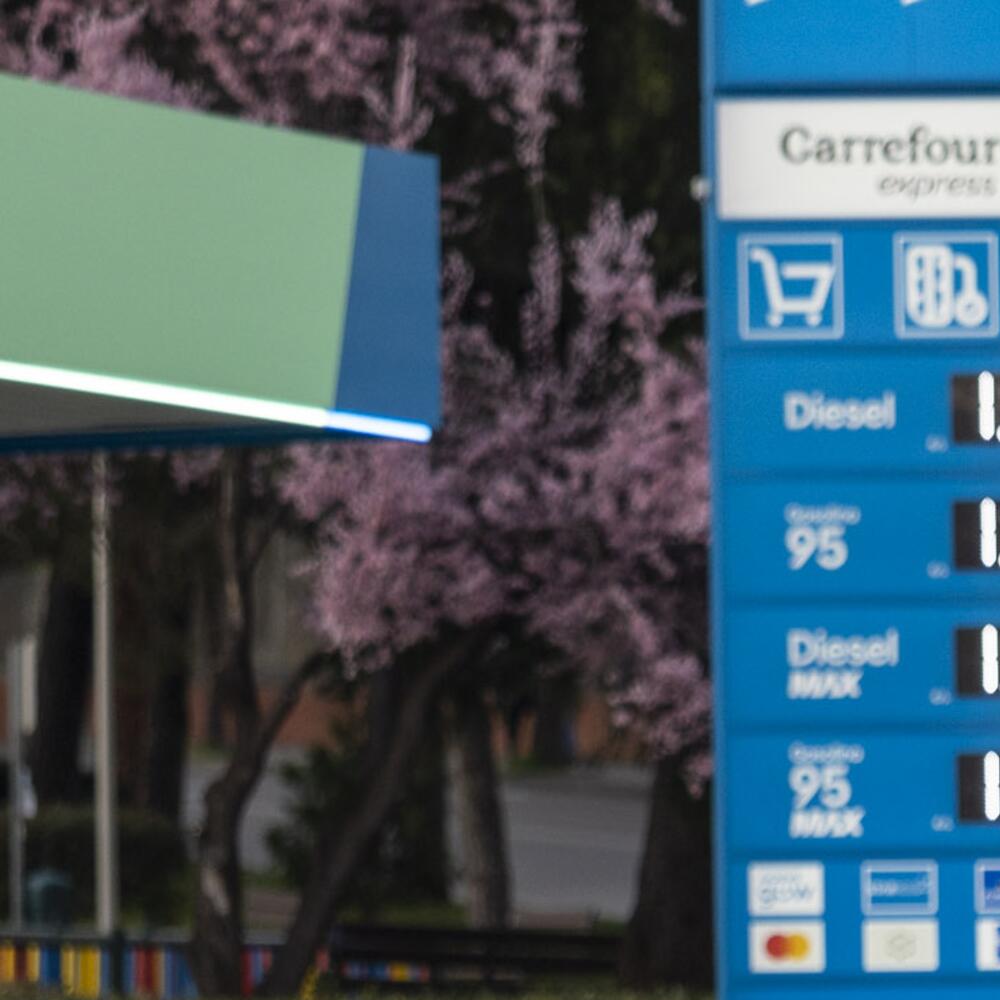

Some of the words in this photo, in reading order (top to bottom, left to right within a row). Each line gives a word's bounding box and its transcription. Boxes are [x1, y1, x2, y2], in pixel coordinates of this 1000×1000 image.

[779, 123, 1000, 165] Carrefour
[876, 172, 997, 202] express
[784, 392, 895, 430] Diesel
[785, 525, 848, 570] 95
[787, 629, 899, 668] Diesel
[787, 671, 862, 699] MAX
[790, 765, 851, 809] 95
[789, 808, 864, 838] MAX
